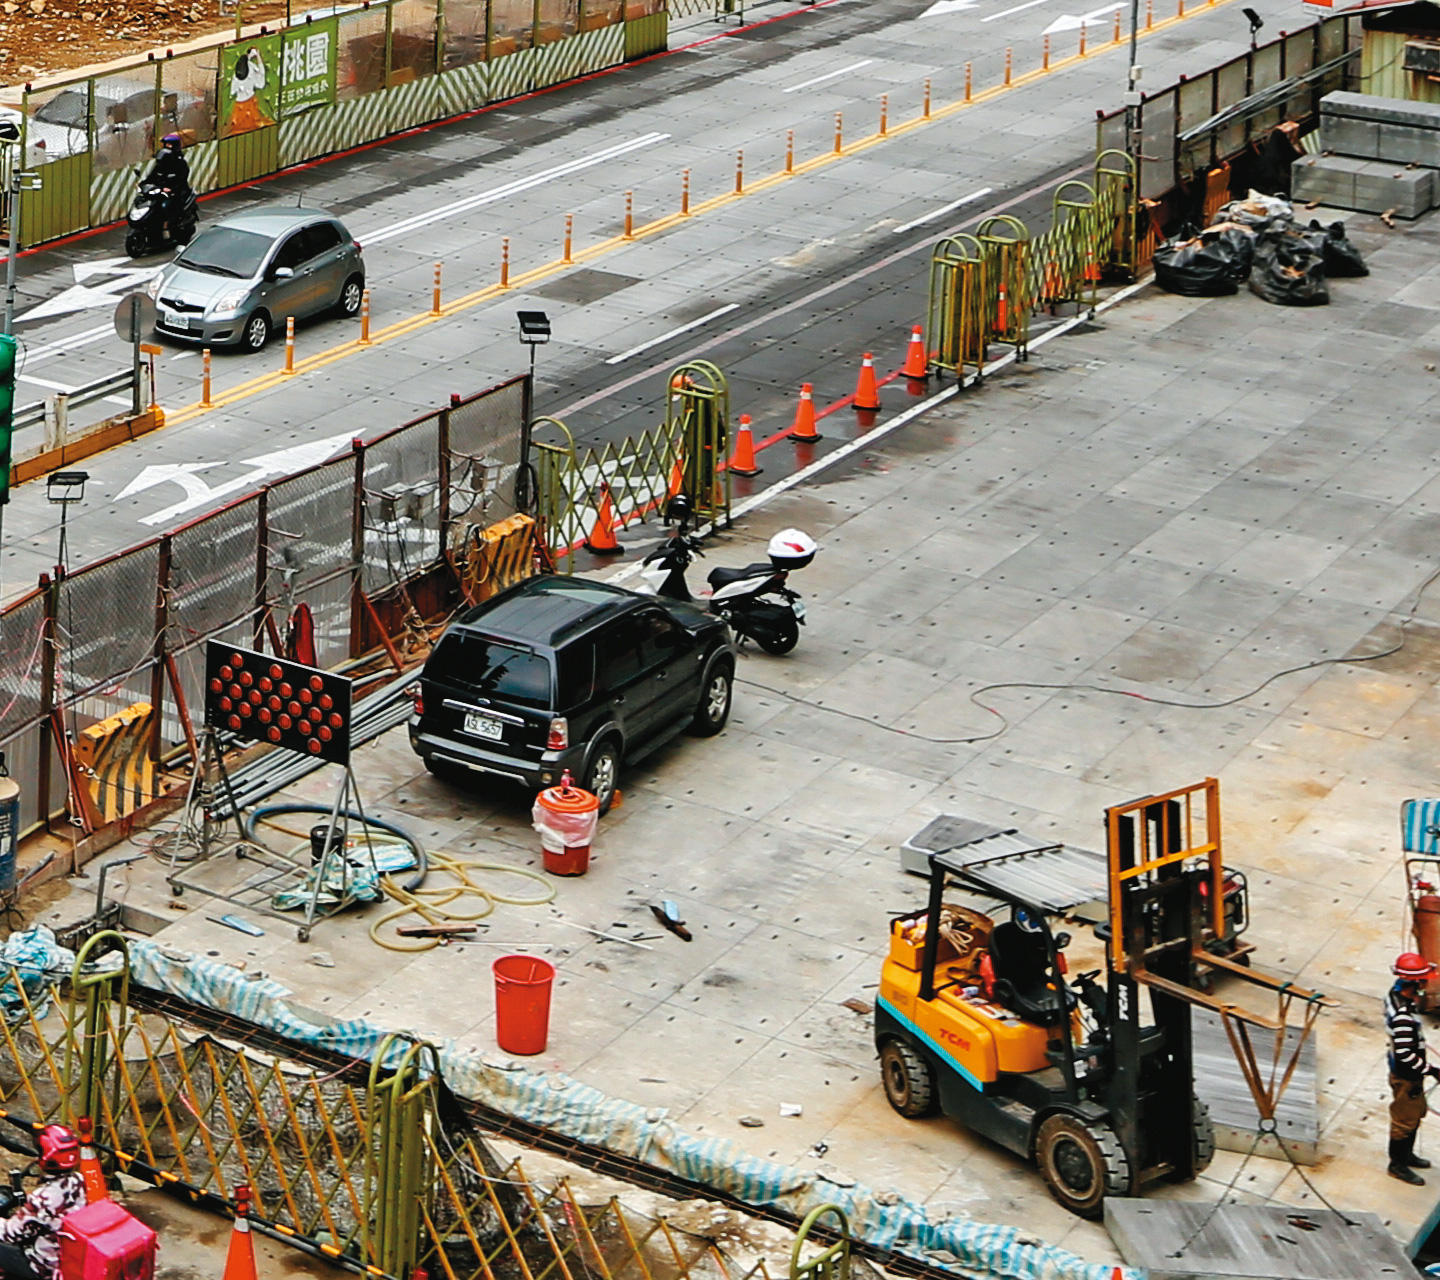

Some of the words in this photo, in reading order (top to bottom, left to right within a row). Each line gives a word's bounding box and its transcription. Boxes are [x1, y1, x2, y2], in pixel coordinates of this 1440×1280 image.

[277, 32, 329, 87] 桃園
[1118, 984, 1129, 1021] TCM
[939, 1028, 970, 1052] TCM
